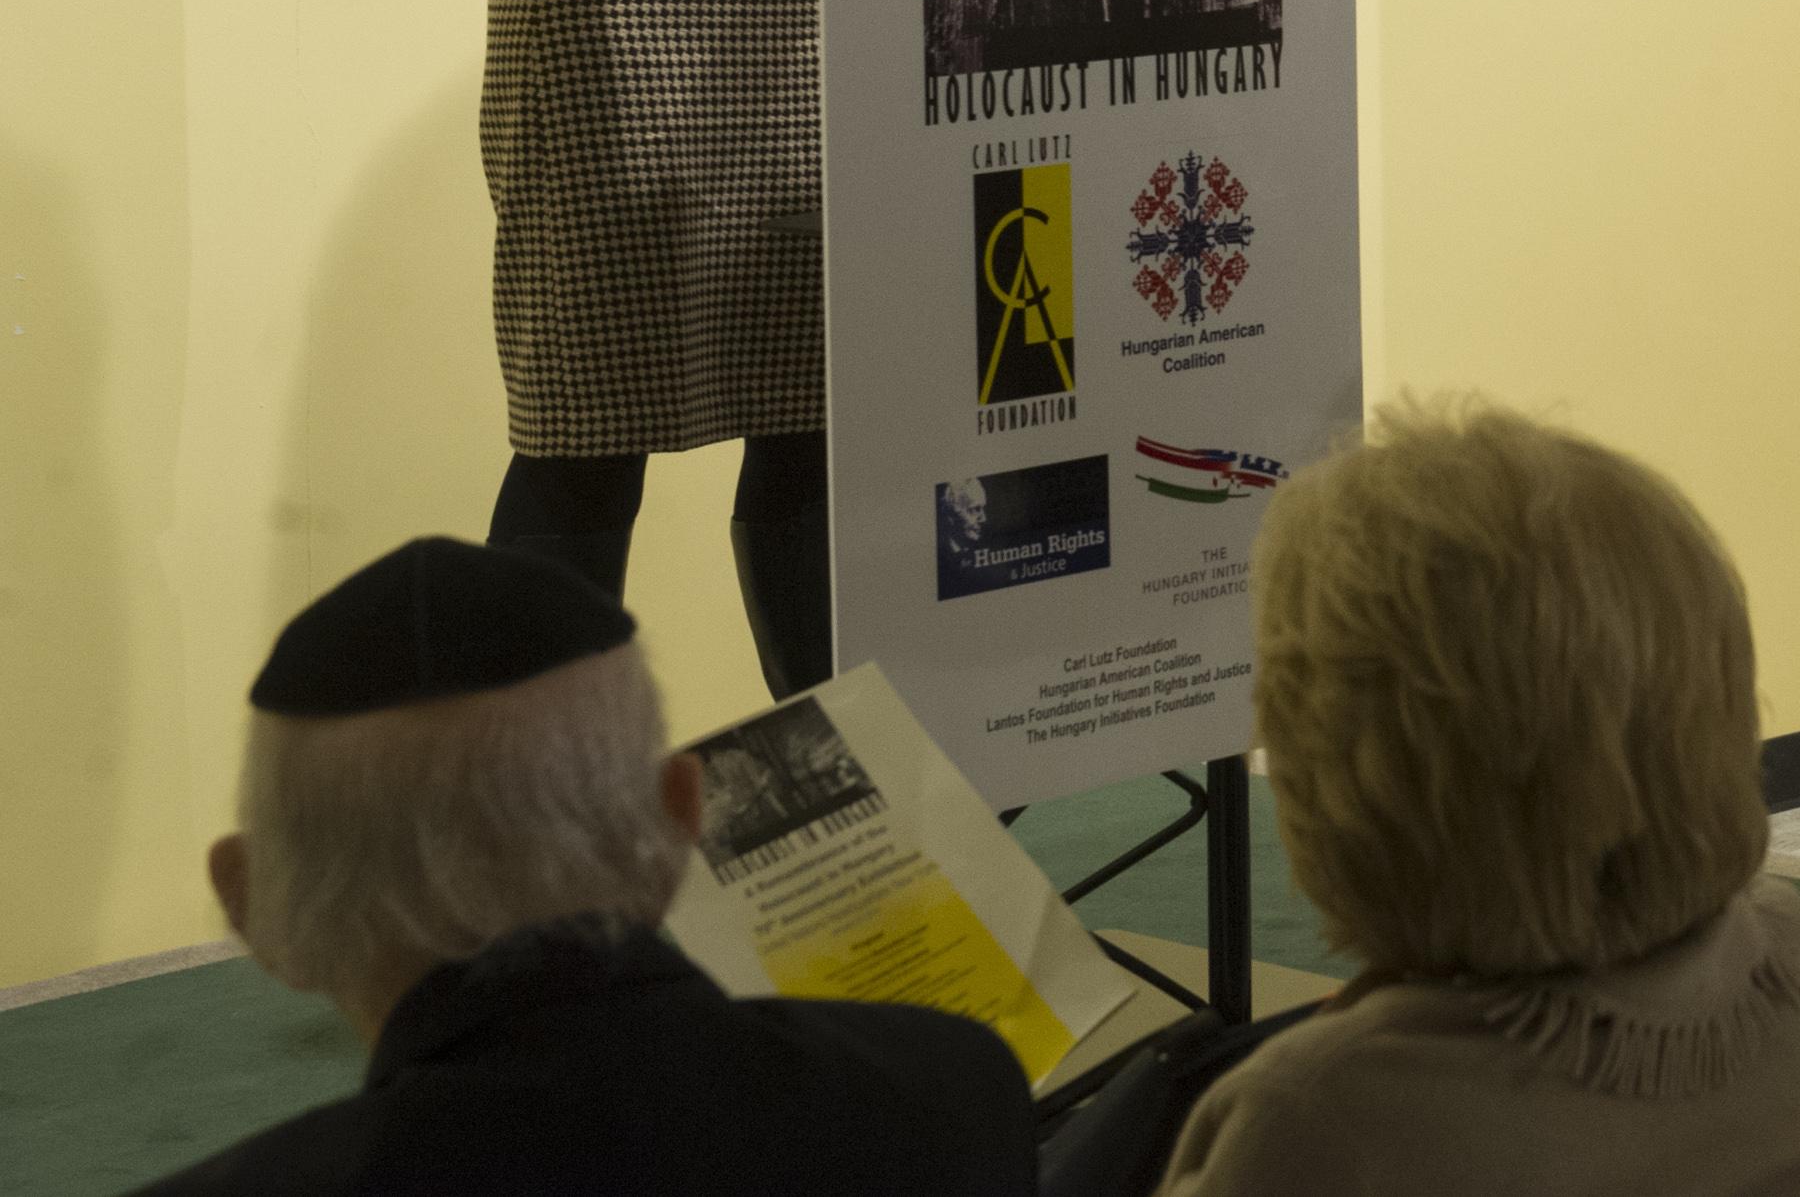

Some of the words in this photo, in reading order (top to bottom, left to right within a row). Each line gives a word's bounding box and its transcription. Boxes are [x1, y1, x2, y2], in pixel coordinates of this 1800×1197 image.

[924, 63, 1089, 126] HOLOCAUST
[1109, 55, 1136, 105] IN
[1156, 42, 1284, 101] HUNGARY
[973, 141, 1018, 169] CARL
[1029, 134, 1072, 161] LUTZ
[1121, 330, 1195, 357] Hungarian
[1199, 321, 1265, 345] American
[1163, 351, 1226, 374] Coalition
[977, 396, 1077, 435] FOUNDATION
[974, 542, 1043, 568] Human
[1048, 530, 1106, 554] Rights
[1201, 546, 1228, 562] THE
[1021, 557, 1068, 579] Justice
[1142, 569, 1207, 594] HUNGARY
[1212, 562, 1249, 579] INITIA
[1173, 580, 1248, 606] FOUNDATIO
[1064, 656, 1087, 673] Carl
[1090, 652, 1113, 668] Lutz
[1116, 638, 1177, 662] Foundation
[1039, 676, 1096, 699] Hungarian
[1099, 663, 1151, 686] American
[1154, 653, 1202, 674] Coalition
[986, 713, 1025, 733] Lantos
[1028, 697, 1092, 723] Foundation
[1094, 692, 1109, 708] for
[1112, 685, 1150, 705] Human
[1154, 674, 1188, 696] Rights
[1191, 669, 1211, 686] and
[1213, 662, 1252, 681] Justice
[1027, 726, 1047, 744] The
[1050, 716, 1097, 739] Hungary
[1100, 704, 1151, 727] Initiatives
[1155, 690, 1216, 714] Foundation
